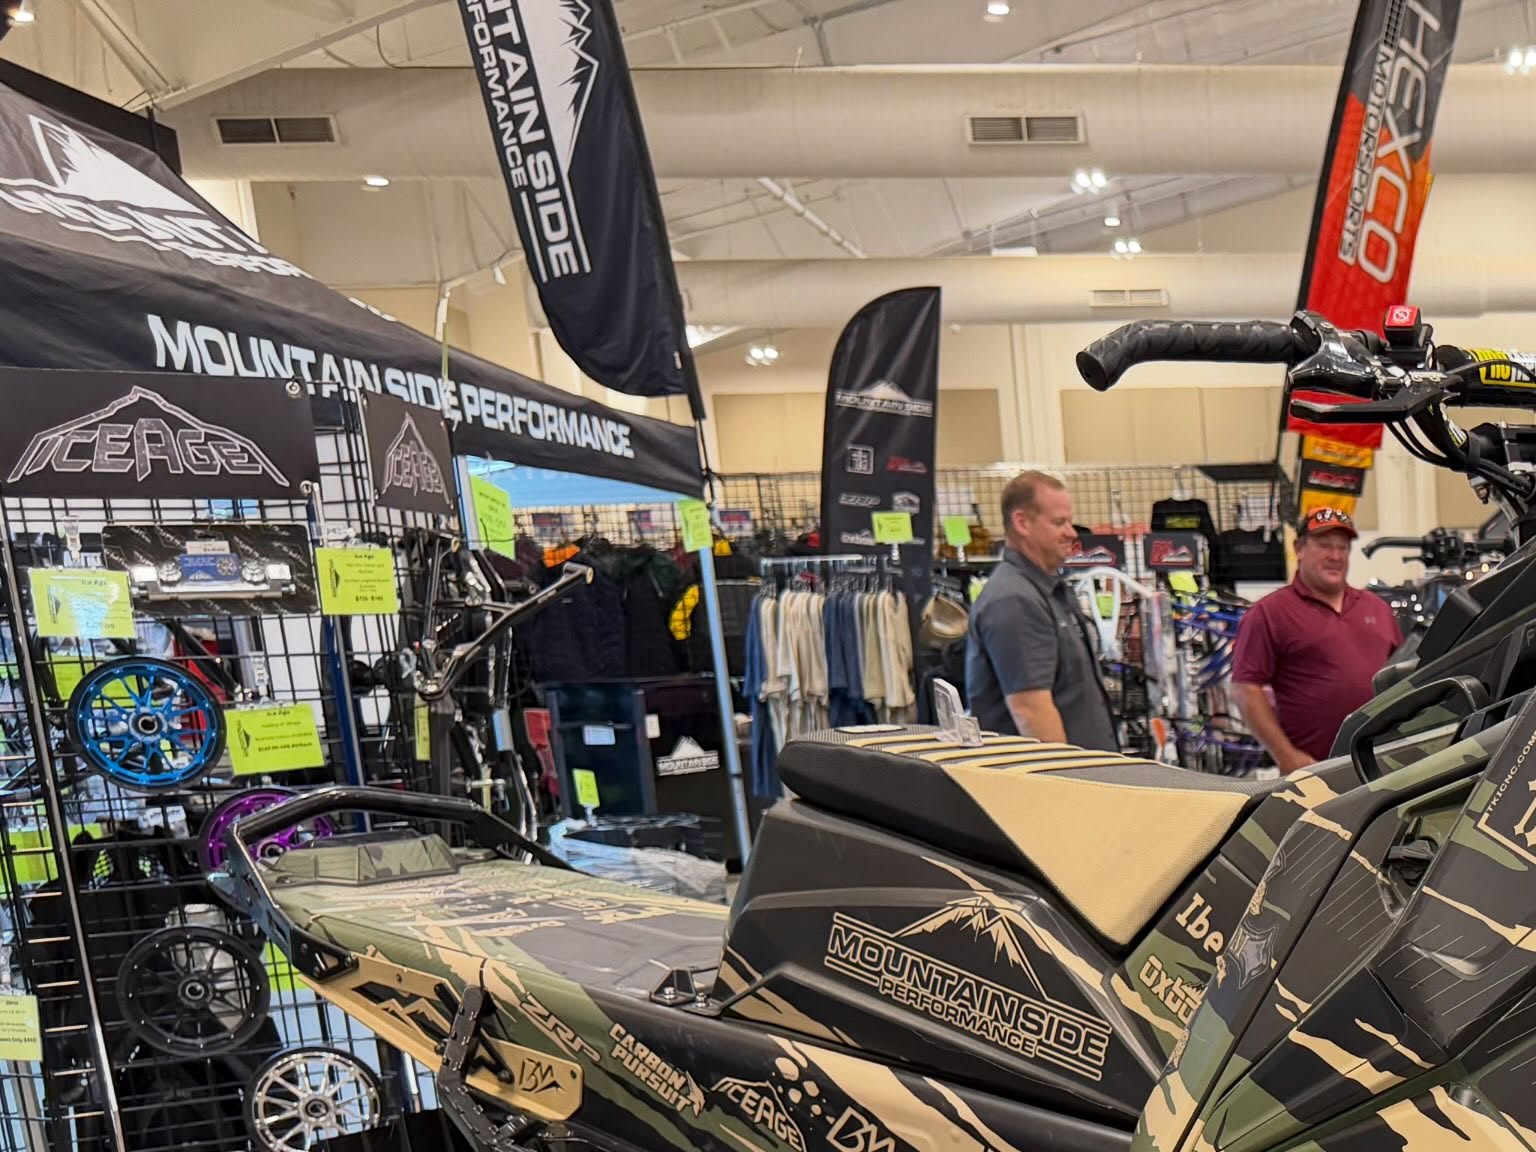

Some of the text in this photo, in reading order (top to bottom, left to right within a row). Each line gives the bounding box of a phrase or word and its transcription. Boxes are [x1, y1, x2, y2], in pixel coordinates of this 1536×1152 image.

[1339, 51, 1391, 258] MOTORSPORTS
[1358, 0, 1440, 283] HEXCO
[526, 149, 580, 279] SIDE
[147, 313, 635, 459] MOUNTAIN SIDE PERFORMANCE
[609, 1023, 687, 1093] CARBON
[828, 924, 1110, 1066] MOUNTAIN SIDE
[879, 976, 1039, 1058] PERFORMANCE
[610, 1044, 692, 1115] PURSUIT
